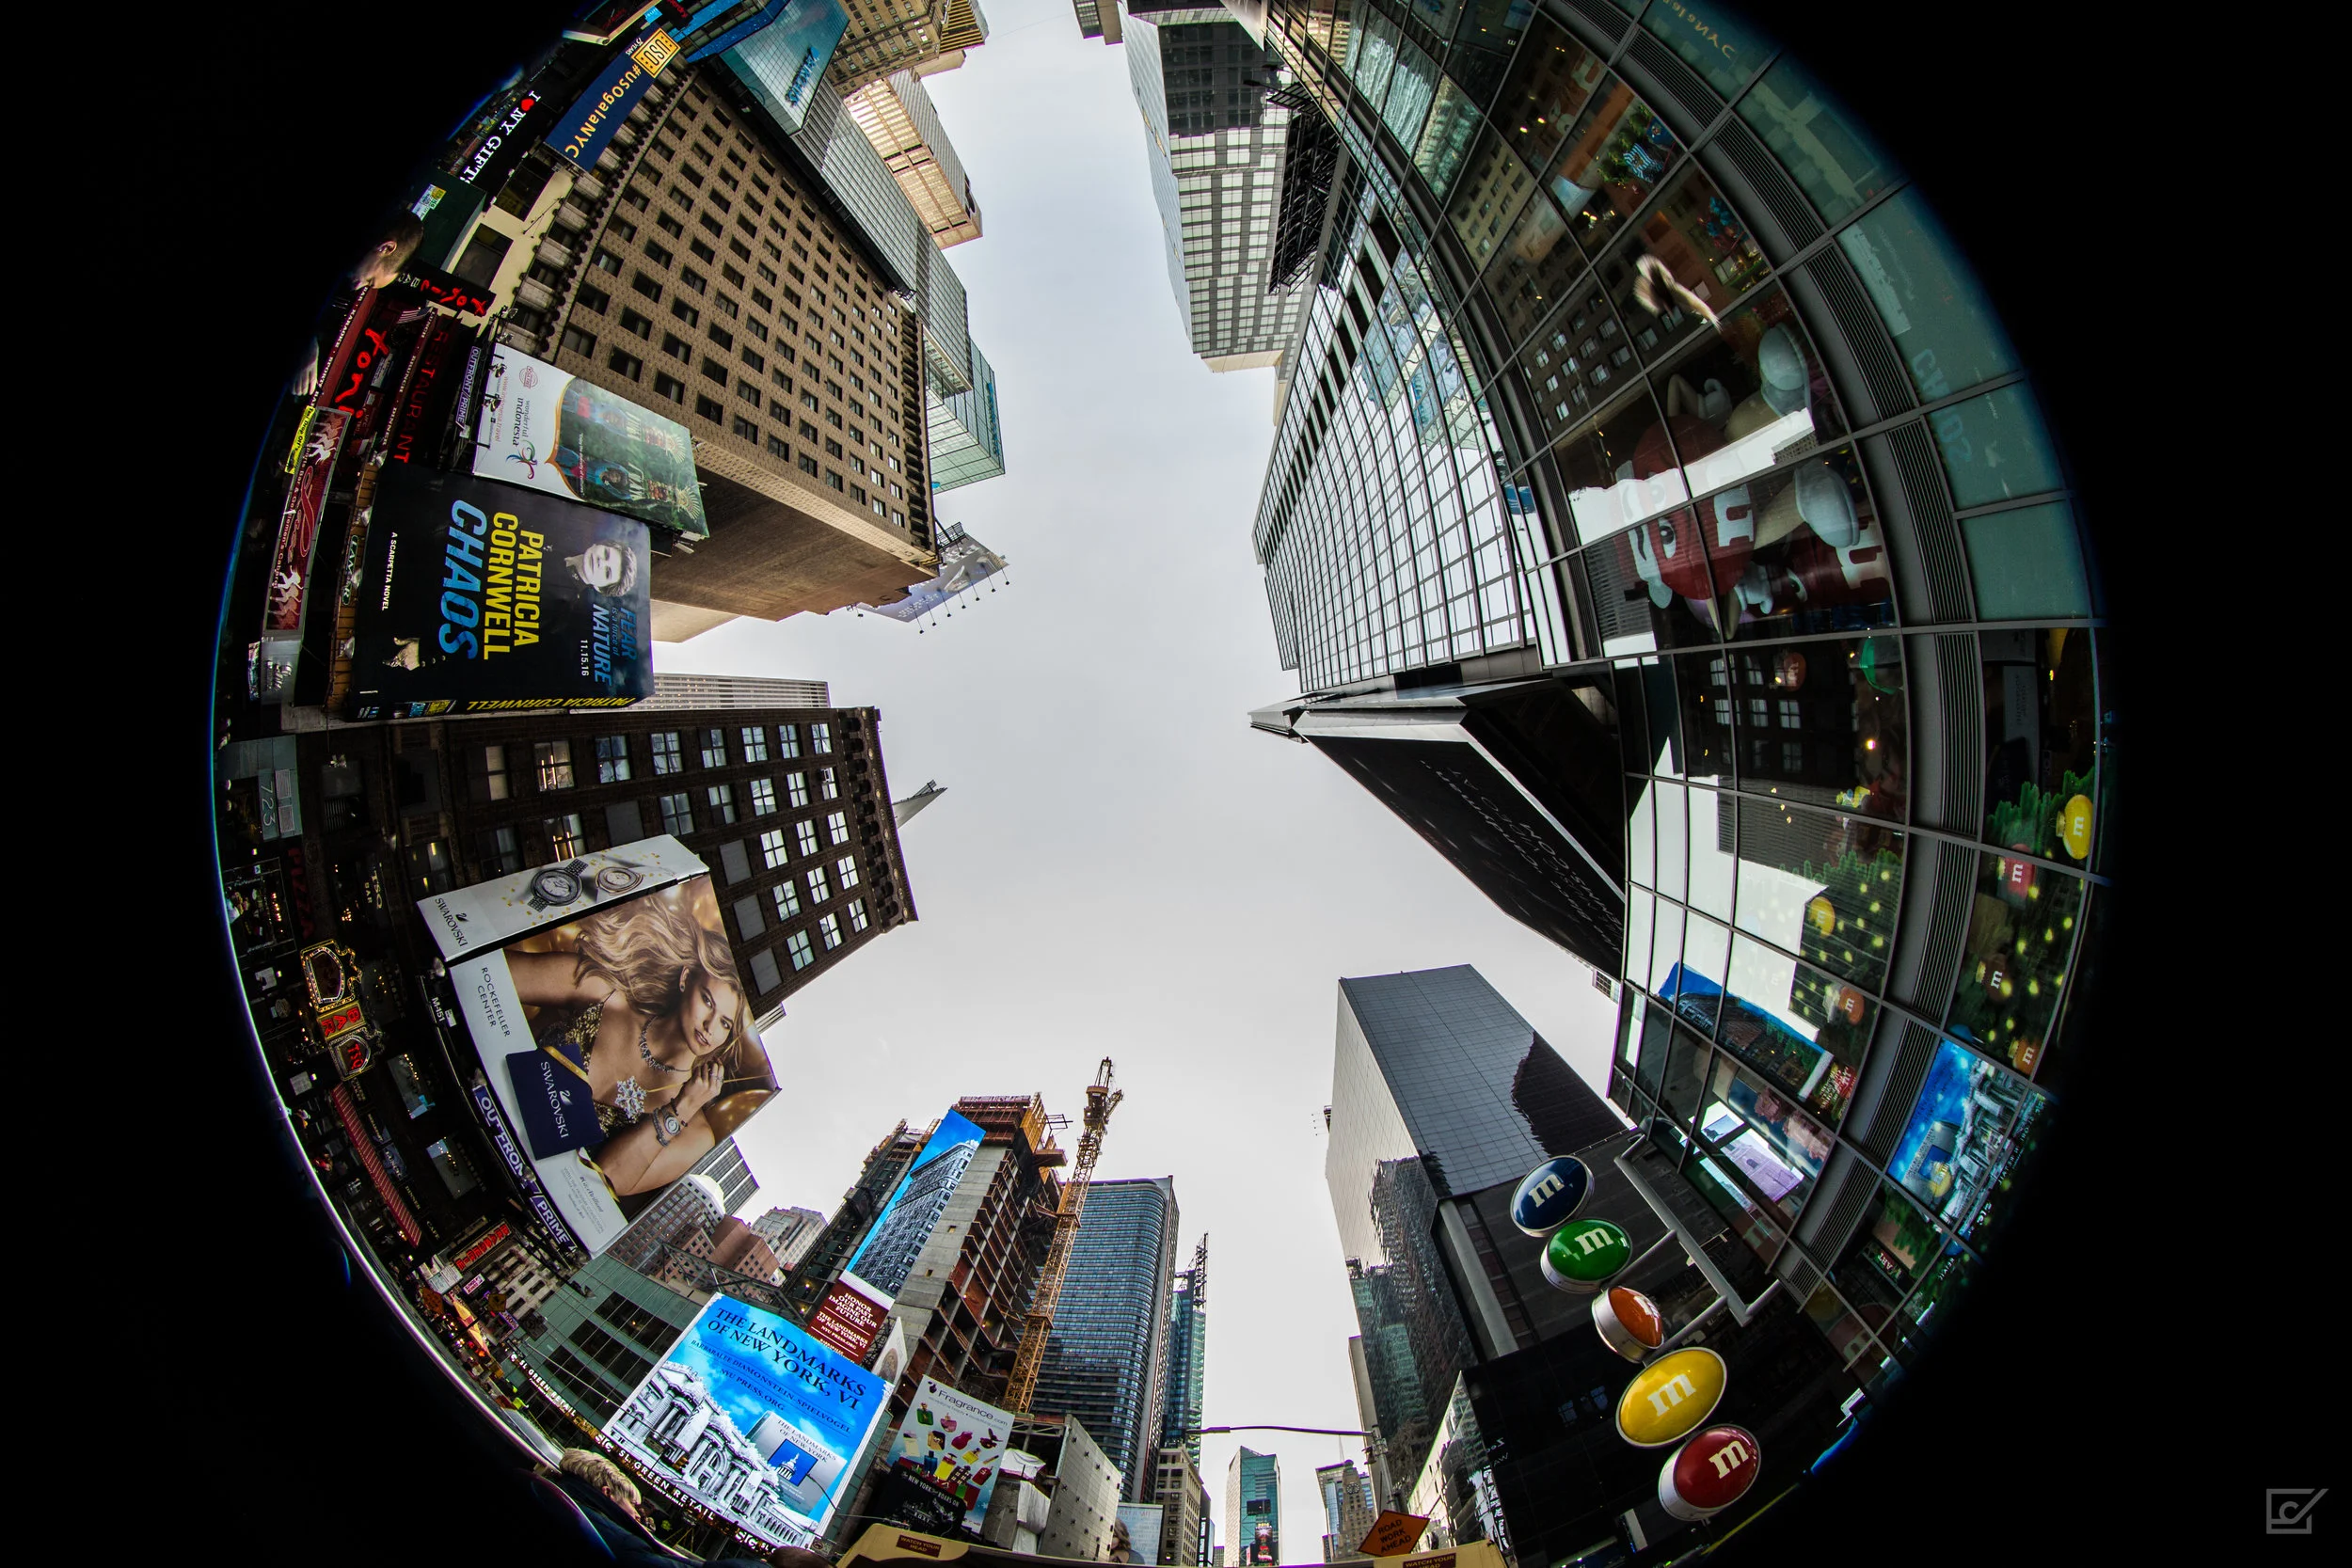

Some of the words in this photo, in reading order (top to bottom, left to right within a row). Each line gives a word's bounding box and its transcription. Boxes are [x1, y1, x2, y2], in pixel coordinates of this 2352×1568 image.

[644, 39, 670, 66] USO
[565, 63, 642, 158] #USOgalaNYC
[393, 331, 449, 463] RESTAURANT
[513, 397, 524, 446] indonesia
[385, 539, 397, 583] SCARPETTA
[438, 499, 487, 659] CHAOS
[484, 512, 518, 660] CORNWELL
[515, 530, 544, 646] PATRICIA
[381, 585, 391, 611] NOVEL
[593, 603, 612, 687] NATURE
[620, 607, 638, 660] FEAR
[580, 639, 590, 676] 11.15.16
[467, 698, 564, 711] CORNWELL
[563, 697, 636, 707] PATRICIA
[260, 781, 276, 827] 723
[2073, 816, 2085, 837] m
[2011, 863, 2024, 883] m
[364, 881, 373, 904] BAR
[435, 897, 468, 947] SWAROVSKI
[1990, 970, 2003, 989] m
[477, 985, 497, 1027] CENTER
[481, 967, 511, 1037] ROCKEFELLER
[321, 1007, 361, 1037] BAR
[347, 1043, 363, 1070] TSQ
[2022, 1047, 2035, 1065] m
[540, 1061, 569, 1138] SWAROVSKI
[481, 1096, 532, 1187] OUTFRON
[405, 1185, 421, 1211] DINNER
[1527, 1173, 1565, 1208] m
[426, 1220, 440, 1241] CAFE
[1574, 1227, 1615, 1256] m
[829, 1294, 861, 1320] IMAGINE
[860, 1315, 877, 1329] OUR
[835, 1307, 866, 1327] FUTURE
[838, 1295, 854, 1309] OUR
[853, 1304, 873, 1319] PAST
[845, 1292, 871, 1312] HONOR
[818, 1311, 832, 1323] THE
[830, 1318, 868, 1344] LANDMARKS
[825, 1321, 840, 1333] NEW
[707, 1320, 731, 1337] OF
[729, 1330, 771, 1353] NEW
[772, 1349, 831, 1397] YORK,
[837, 1390, 859, 1411] VI
[716, 1307, 749, 1329] THE
[750, 1323, 866, 1397] LANDMARKS
[528, 1368, 550, 1390] GREEN
[551, 1391, 578, 1417] RETAIL
[691, 1338, 733, 1364] BARBARALEE
[734, 1360, 850, 1433] DIAMONSTEIN-SPIELVOGEL
[720, 1368, 735, 1379] NYU
[736, 1376, 786, 1411] PRESS.ORG
[1647, 1373, 1696, 1417] m
[777, 1418, 791, 1431] THE
[789, 1426, 836, 1461] LANDMARKS
[779, 1428, 791, 1438] OF
[790, 1435, 808, 1449] NEW
[808, 1448, 828, 1463] YORK
[1708, 1438, 1749, 1480] m
[633, 1461, 670, 1493] GREEN
[674, 1490, 715, 1521] RETAIL
[908, 1474, 919, 1486] NEW
[919, 1481, 932, 1493] YORK
[900, 1536, 923, 1547] WATCH
[922, 1542, 940, 1551] YOUR
[1377, 1519, 1402, 1534] ROAD
[1379, 1529, 1406, 1544] WORK
[1381, 1535, 1411, 1552] AHEAD
[910, 1544, 928, 1553] HEAD
[1405, 1558, 1429, 1568] WATCH
[1432, 1554, 1455, 1563] YOUR
